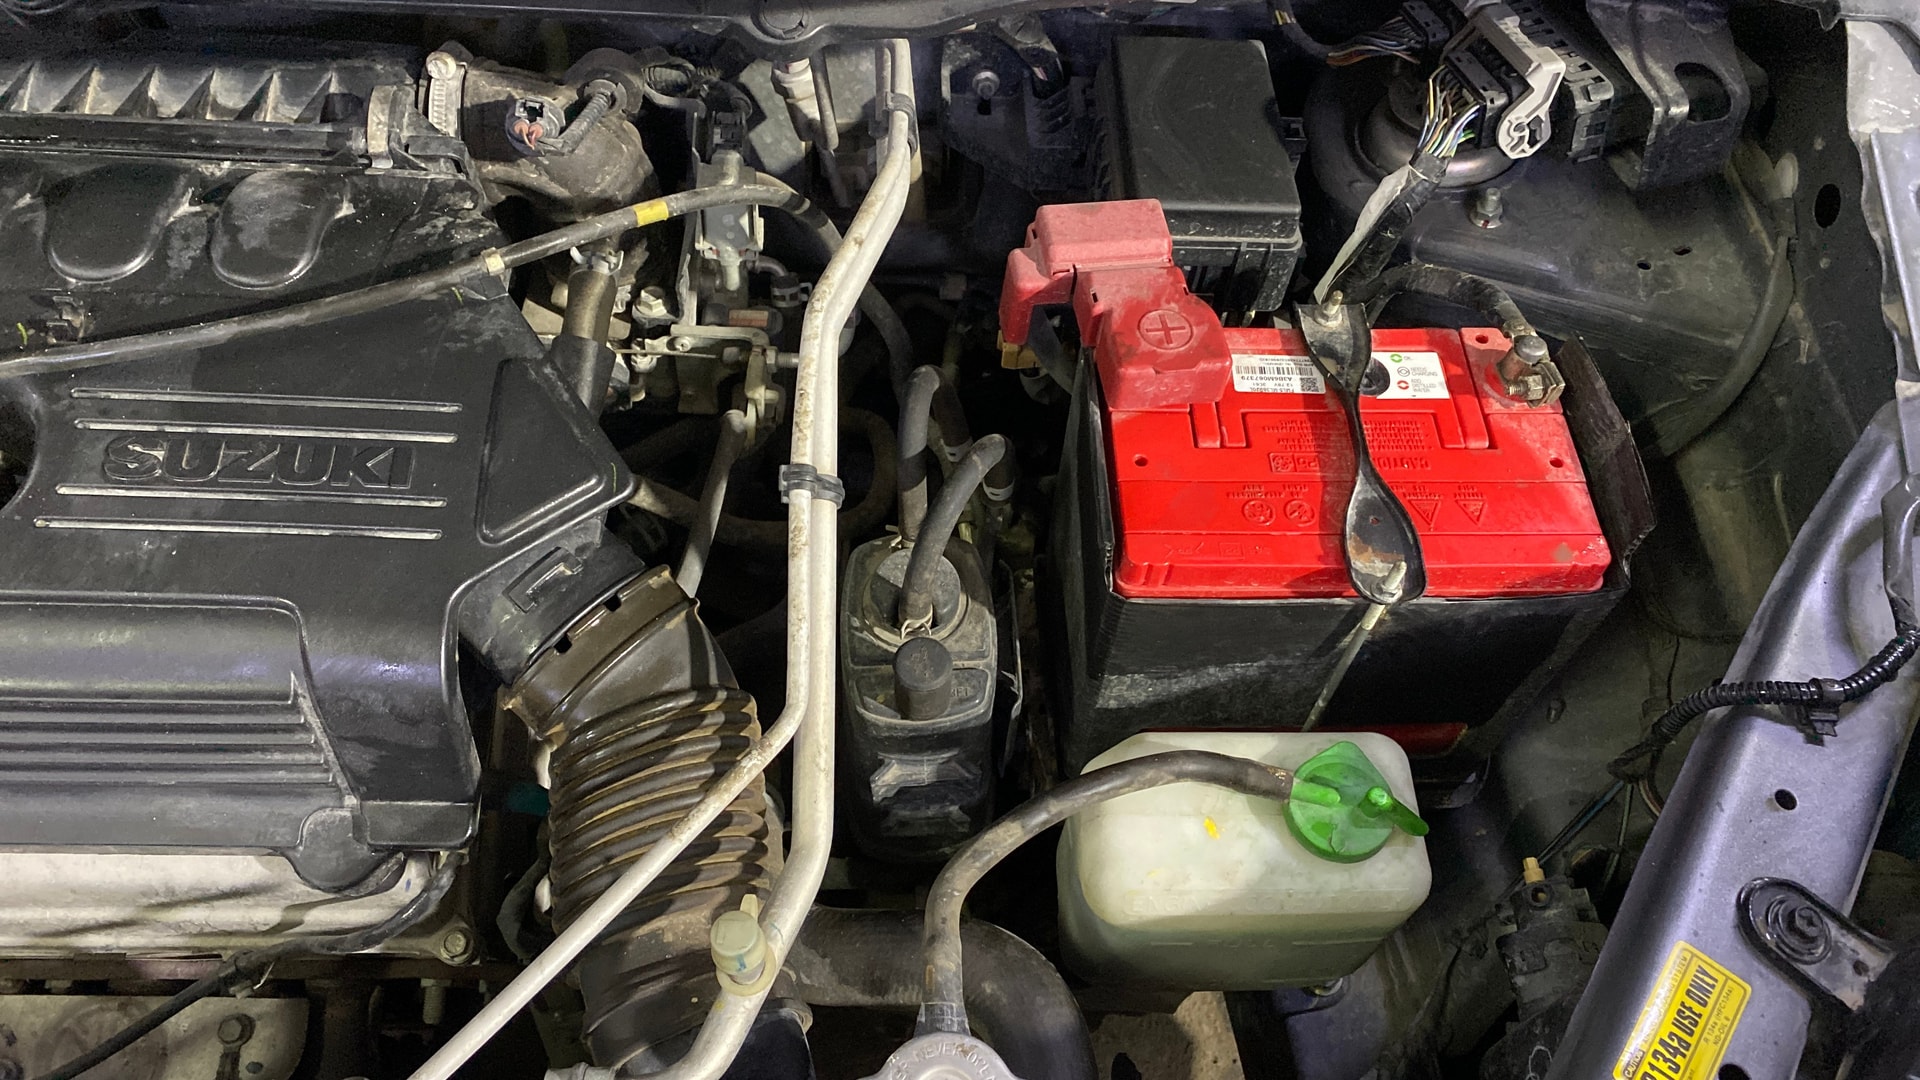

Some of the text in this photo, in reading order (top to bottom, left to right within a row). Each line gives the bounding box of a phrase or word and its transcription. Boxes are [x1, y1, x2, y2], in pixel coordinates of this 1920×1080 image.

[103, 435, 414, 489] SUZUKI
[1685, 965, 1719, 1009] ONLY
[1670, 1000, 1703, 1038] USE
